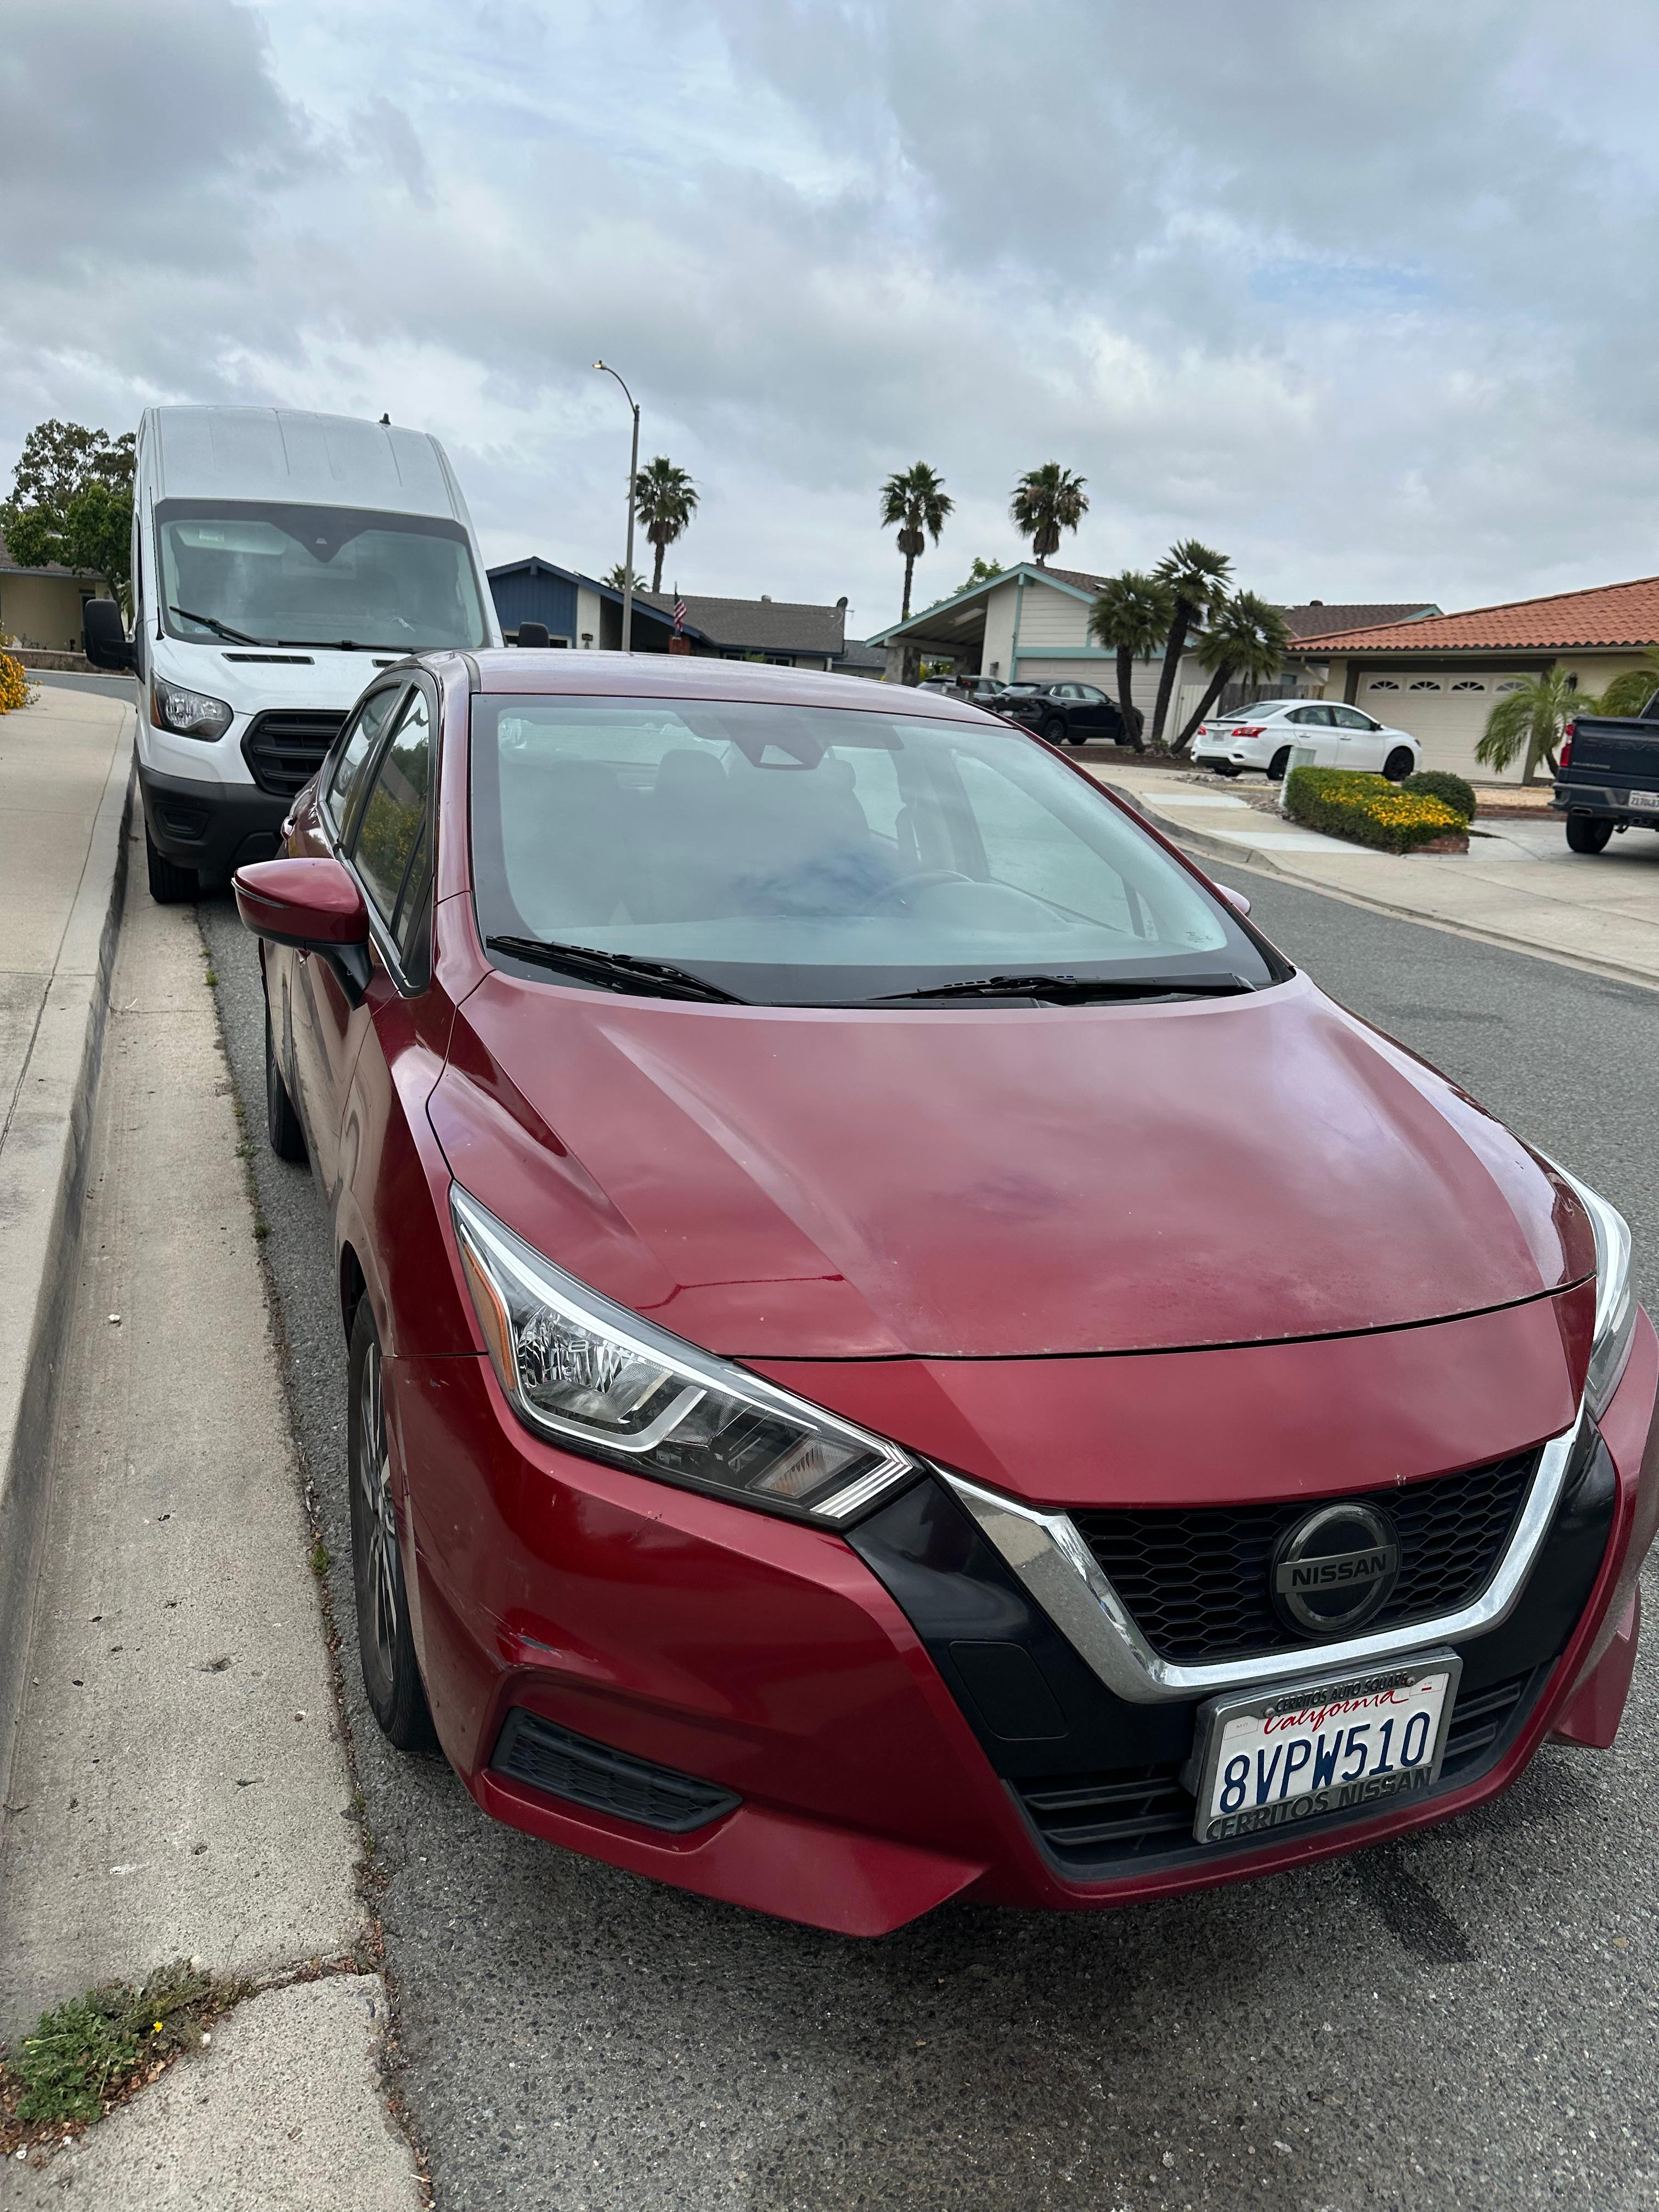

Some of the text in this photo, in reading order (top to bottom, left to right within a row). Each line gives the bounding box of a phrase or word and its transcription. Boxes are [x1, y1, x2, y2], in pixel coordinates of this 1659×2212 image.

[1291, 1553, 1386, 1587] NISSAN
[1263, 1689, 1409, 1735] California
[1276, 1671, 1408, 1713] CERRITOS AUTO SQUARE
[1219, 1712, 1431, 1814] 8VPW510
[1205, 1766, 1433, 1842] CERRITOS NISSAN
